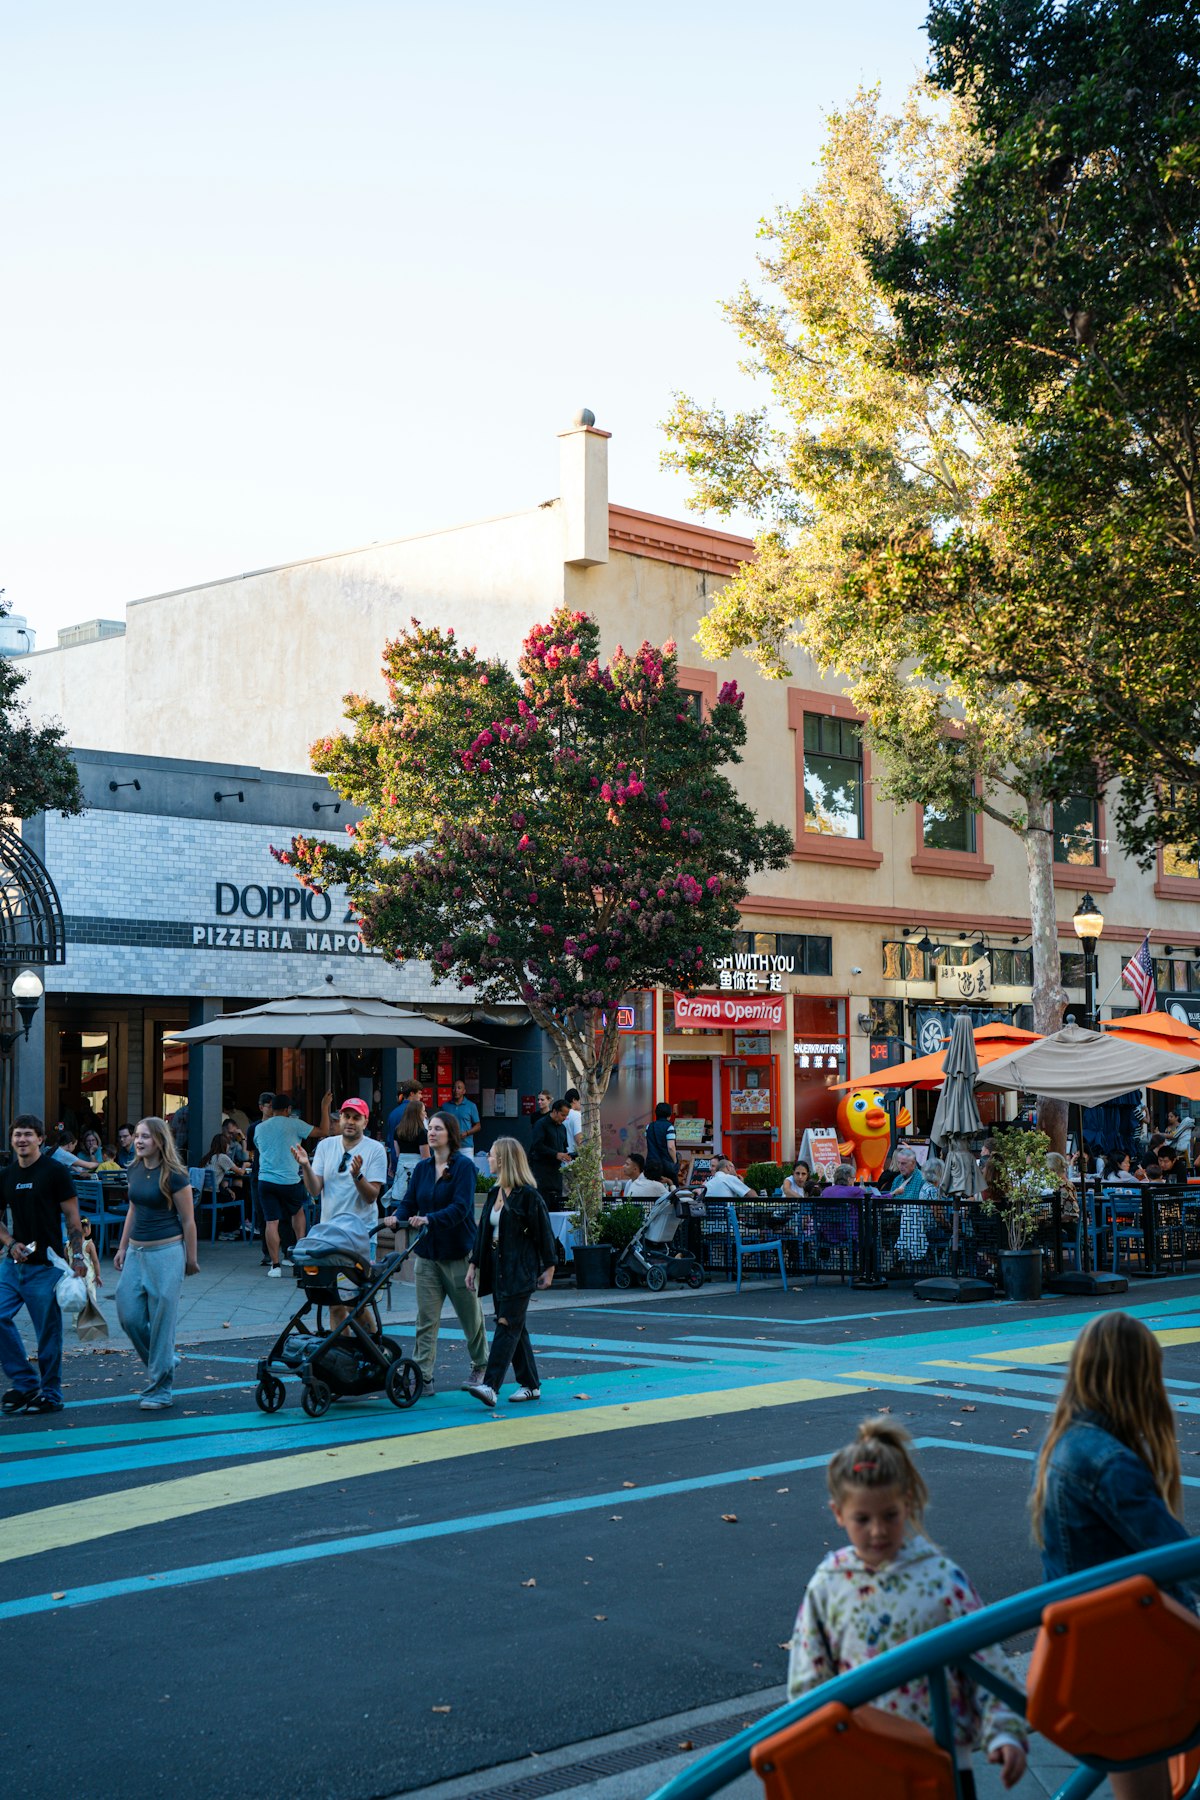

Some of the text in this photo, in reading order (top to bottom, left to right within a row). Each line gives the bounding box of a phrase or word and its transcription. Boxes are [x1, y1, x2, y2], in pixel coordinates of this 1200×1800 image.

[215, 881, 332, 923] DOPPIO
[193, 926, 293, 950] PIZZERIA
[734, 953, 769, 971] WITH
[770, 955, 795, 972] YOU
[720, 970, 782, 991] 鱼你在一起
[677, 998, 782, 1024] Grand Opening
[829, 1044, 844, 1054] FISH
